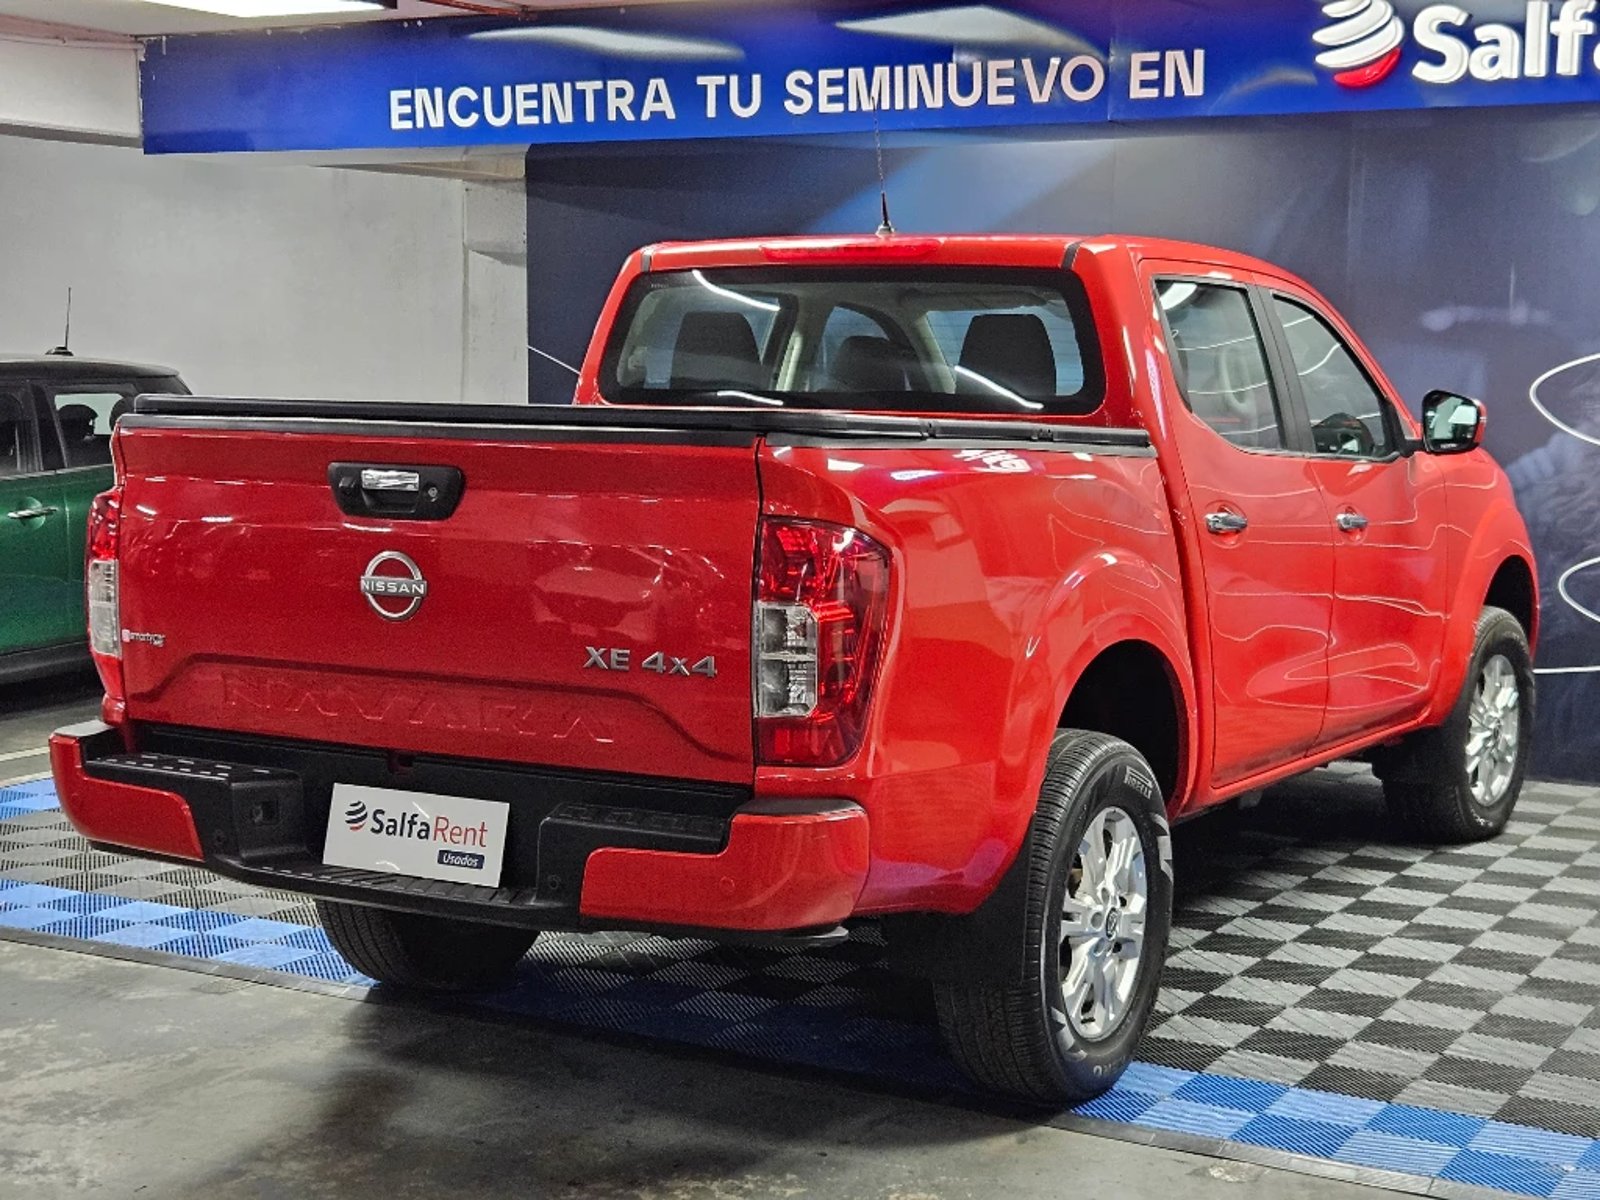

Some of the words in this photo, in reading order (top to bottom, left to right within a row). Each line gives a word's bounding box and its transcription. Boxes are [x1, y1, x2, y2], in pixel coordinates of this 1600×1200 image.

[1411, 0, 1600, 84] Salf
[389, 78, 676, 131] ENCUENTRA
[696, 74, 762, 118] TU
[783, 55, 1105, 115] SEMINUEVO
[1129, 49, 1205, 100] EN
[362, 579, 425, 595] NISSAN
[583, 646, 631, 671] XE
[641, 651, 718, 678] 4x4
[219, 672, 615, 744] NAVARA
[370, 808, 488, 848] SalfaRent
[442, 852, 479, 868] Usados
